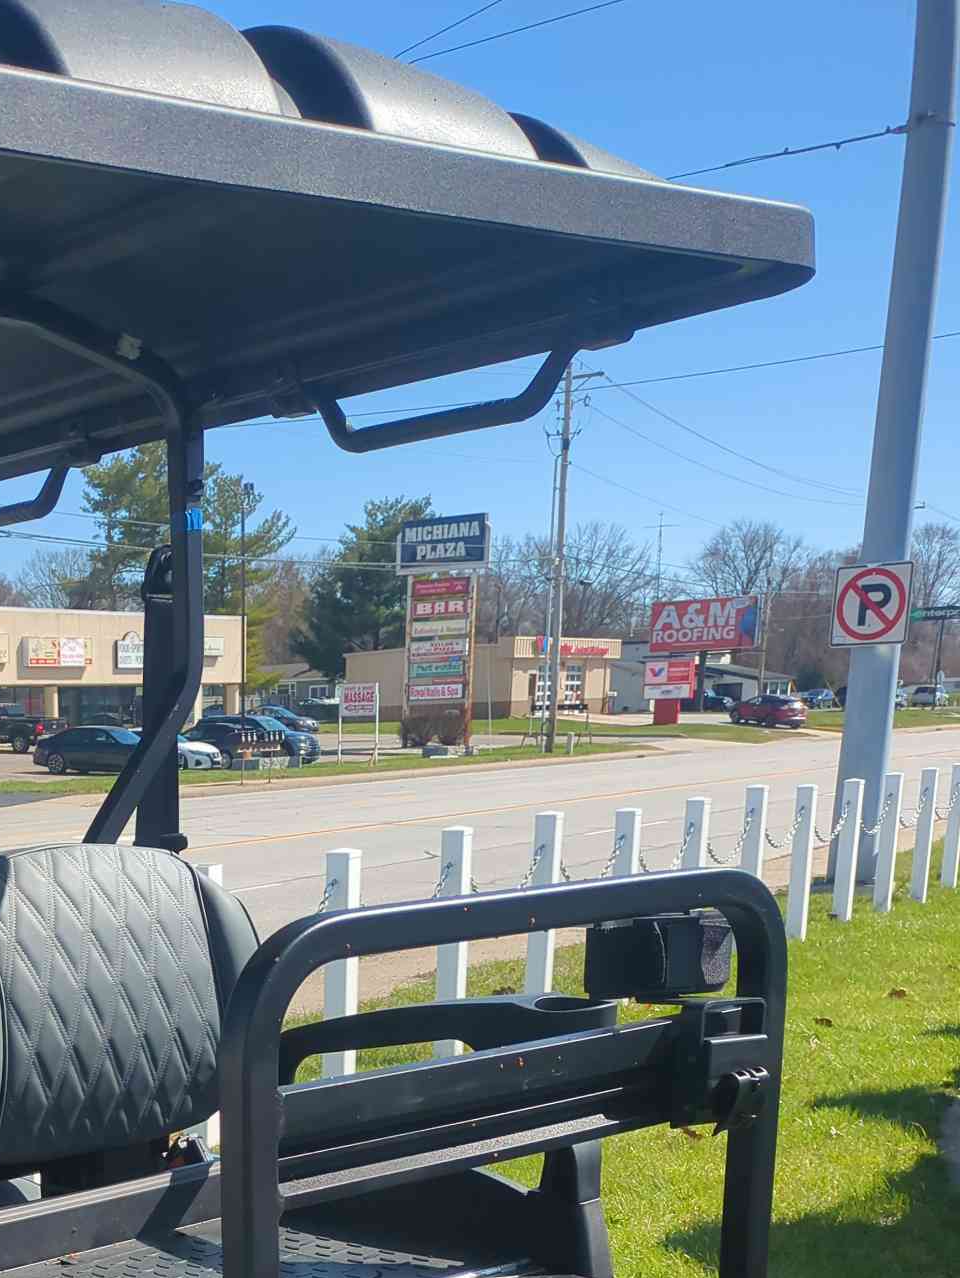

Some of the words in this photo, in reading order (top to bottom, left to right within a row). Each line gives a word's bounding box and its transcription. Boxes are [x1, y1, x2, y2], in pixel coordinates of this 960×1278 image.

[405, 521, 480, 543] MICHIANA
[416, 541, 466, 560] PLAZA
[416, 601, 465, 615] BAR
[858, 583, 892, 626] P
[654, 601, 737, 630] A&M
[652, 626, 736, 643] ROOFING
